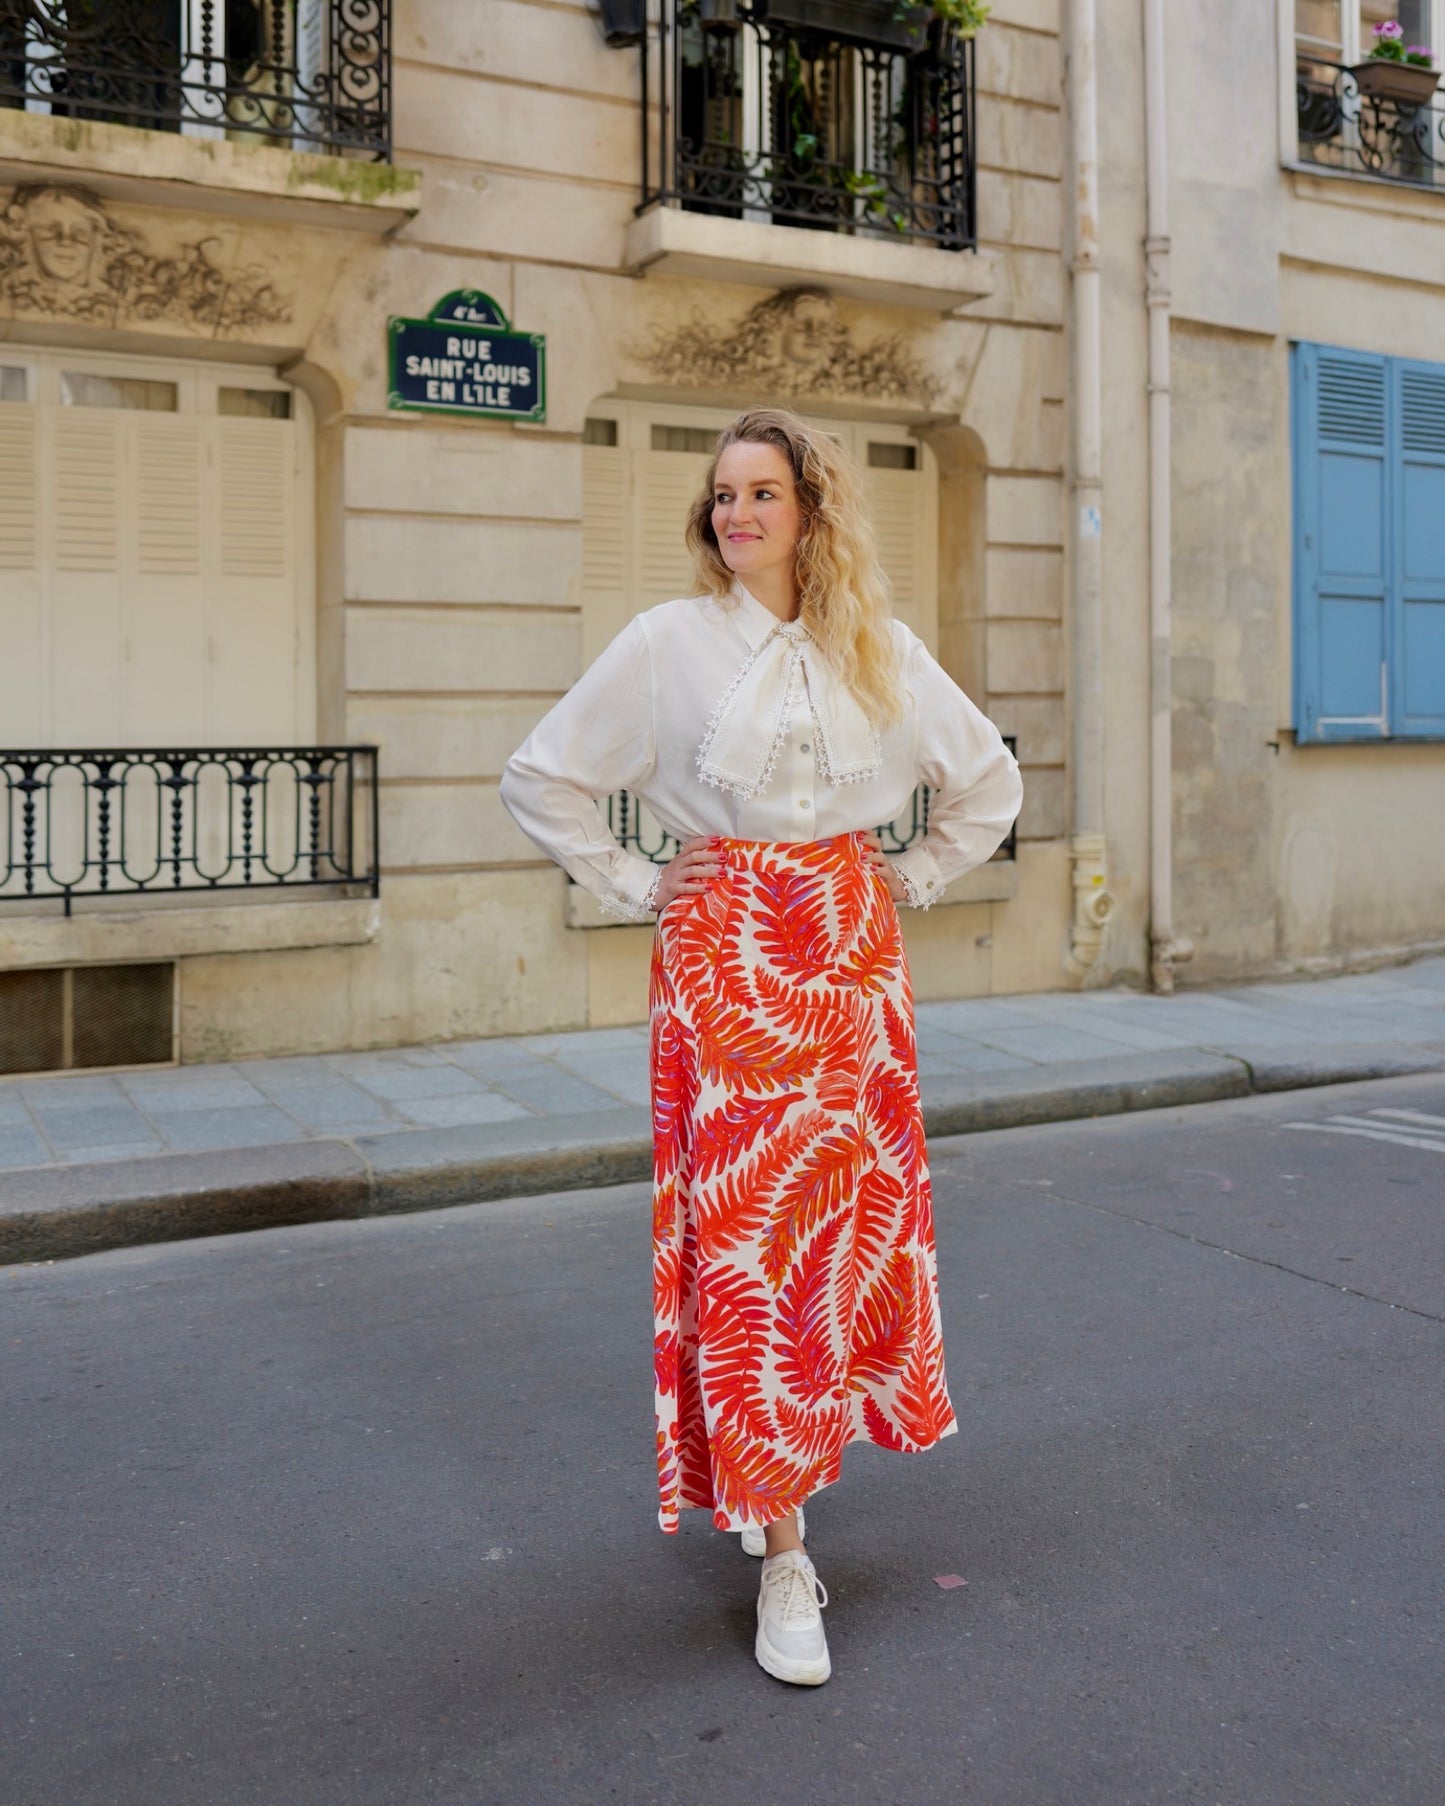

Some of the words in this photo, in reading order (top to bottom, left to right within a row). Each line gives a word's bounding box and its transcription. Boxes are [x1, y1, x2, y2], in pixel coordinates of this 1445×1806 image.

[447, 337, 492, 361] RUE
[406, 355, 531, 387] SAINT-LOUIS
[426, 380, 456, 402] EN
